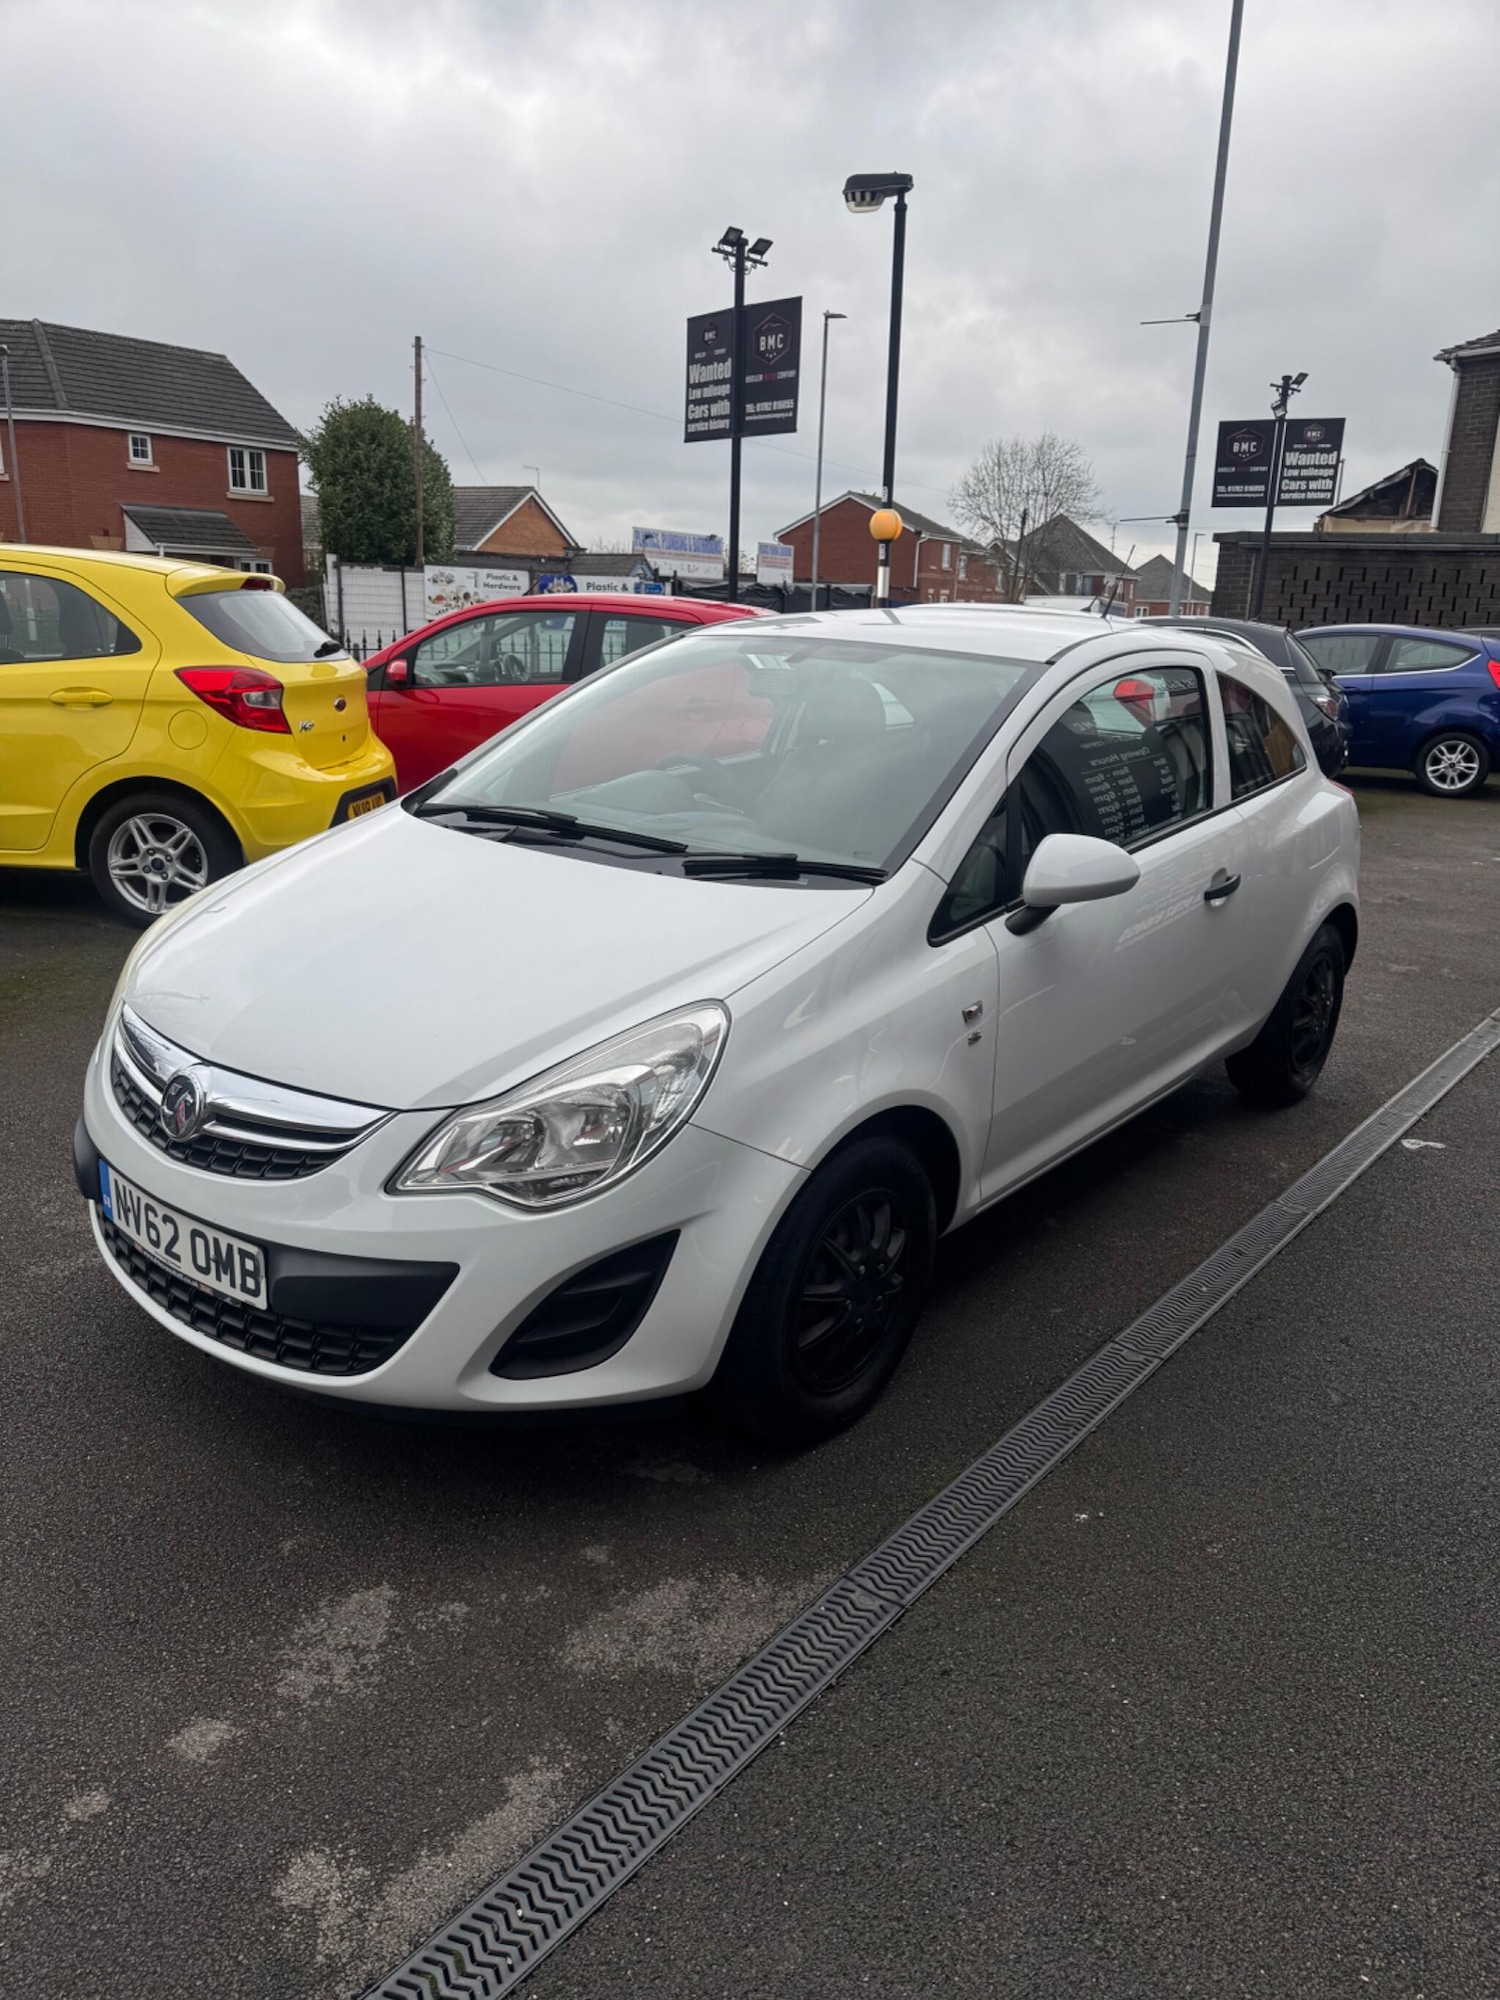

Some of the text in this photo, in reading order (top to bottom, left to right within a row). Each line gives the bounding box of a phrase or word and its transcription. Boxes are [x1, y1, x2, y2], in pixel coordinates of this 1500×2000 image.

[759, 333, 784, 352] BMC
[689, 357, 732, 384] Wanted
[688, 383, 731, 400] Low mileage
[688, 404, 709, 420] Cars
[709, 399, 730, 417] with
[687, 418, 730, 432] service history
[1233, 441, 1257, 453] BMC
[1285, 450, 1338, 466] Wanted
[1283, 467, 1335, 477] Low mileage
[1281, 478, 1333, 490] Cars with
[1280, 491, 1332, 500] service history
[486, 572, 519, 582] Plastic &
[483, 582, 522, 591] Hardware
[586, 581, 618, 592] Plastic
[620, 583, 629, 592] &
[114, 1178, 182, 1263] NV62
[190, 1228, 261, 1298] OMB
